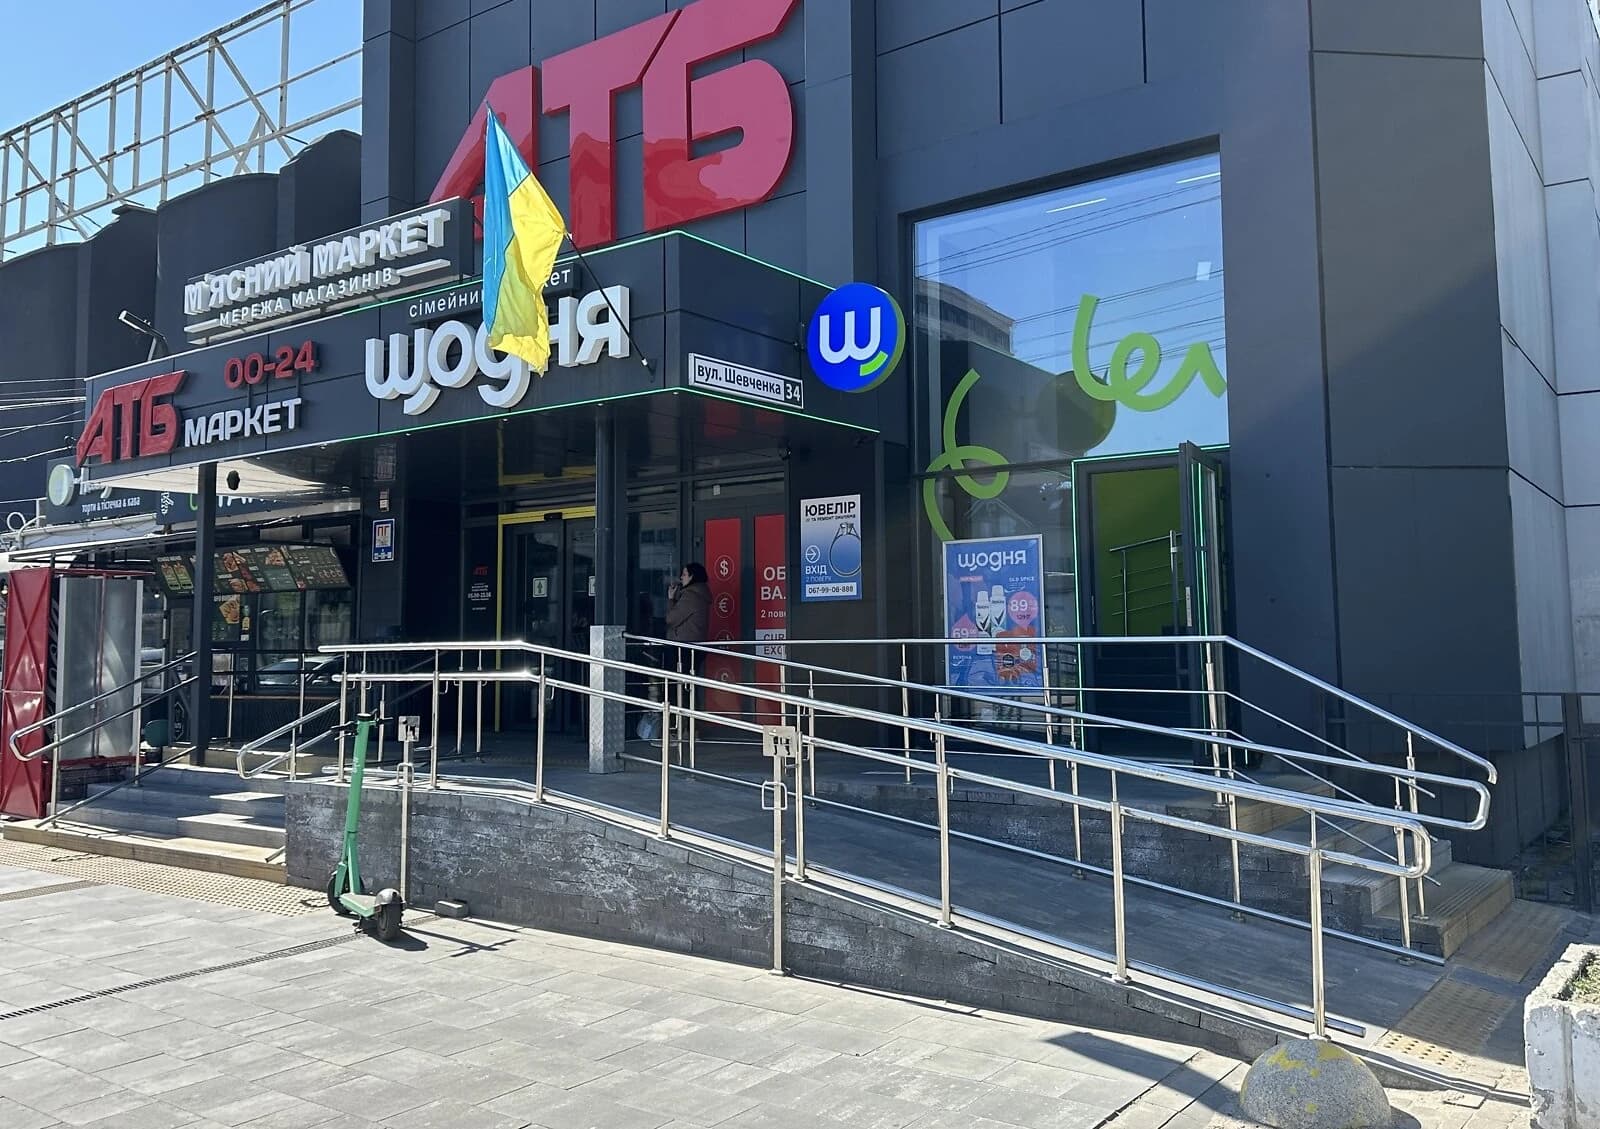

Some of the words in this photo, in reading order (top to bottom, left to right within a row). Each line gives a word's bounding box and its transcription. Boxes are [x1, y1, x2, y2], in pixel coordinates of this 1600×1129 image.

[429, 0, 797, 248] АТБ
[312, 208, 451, 279] МАРКЕТ
[219, 295, 292, 328] МЕРЕЖА
[291, 267, 401, 308] МАГАЗИНІВ
[409, 289, 483, 318] сімейни
[224, 340, 318, 389] 00-24
[697, 364, 722, 384] вул.
[724, 370, 782, 395] Шевченка
[785, 383, 801, 402] 34
[76, 370, 187, 468] АТБ
[184, 397, 302, 447] МАРКЕТ
[805, 501, 856, 517] ЮВЕЛІР
[805, 565, 827, 575] ВХІД
[760, 609, 766, 618] 2
[761, 586, 786, 601] ВА
